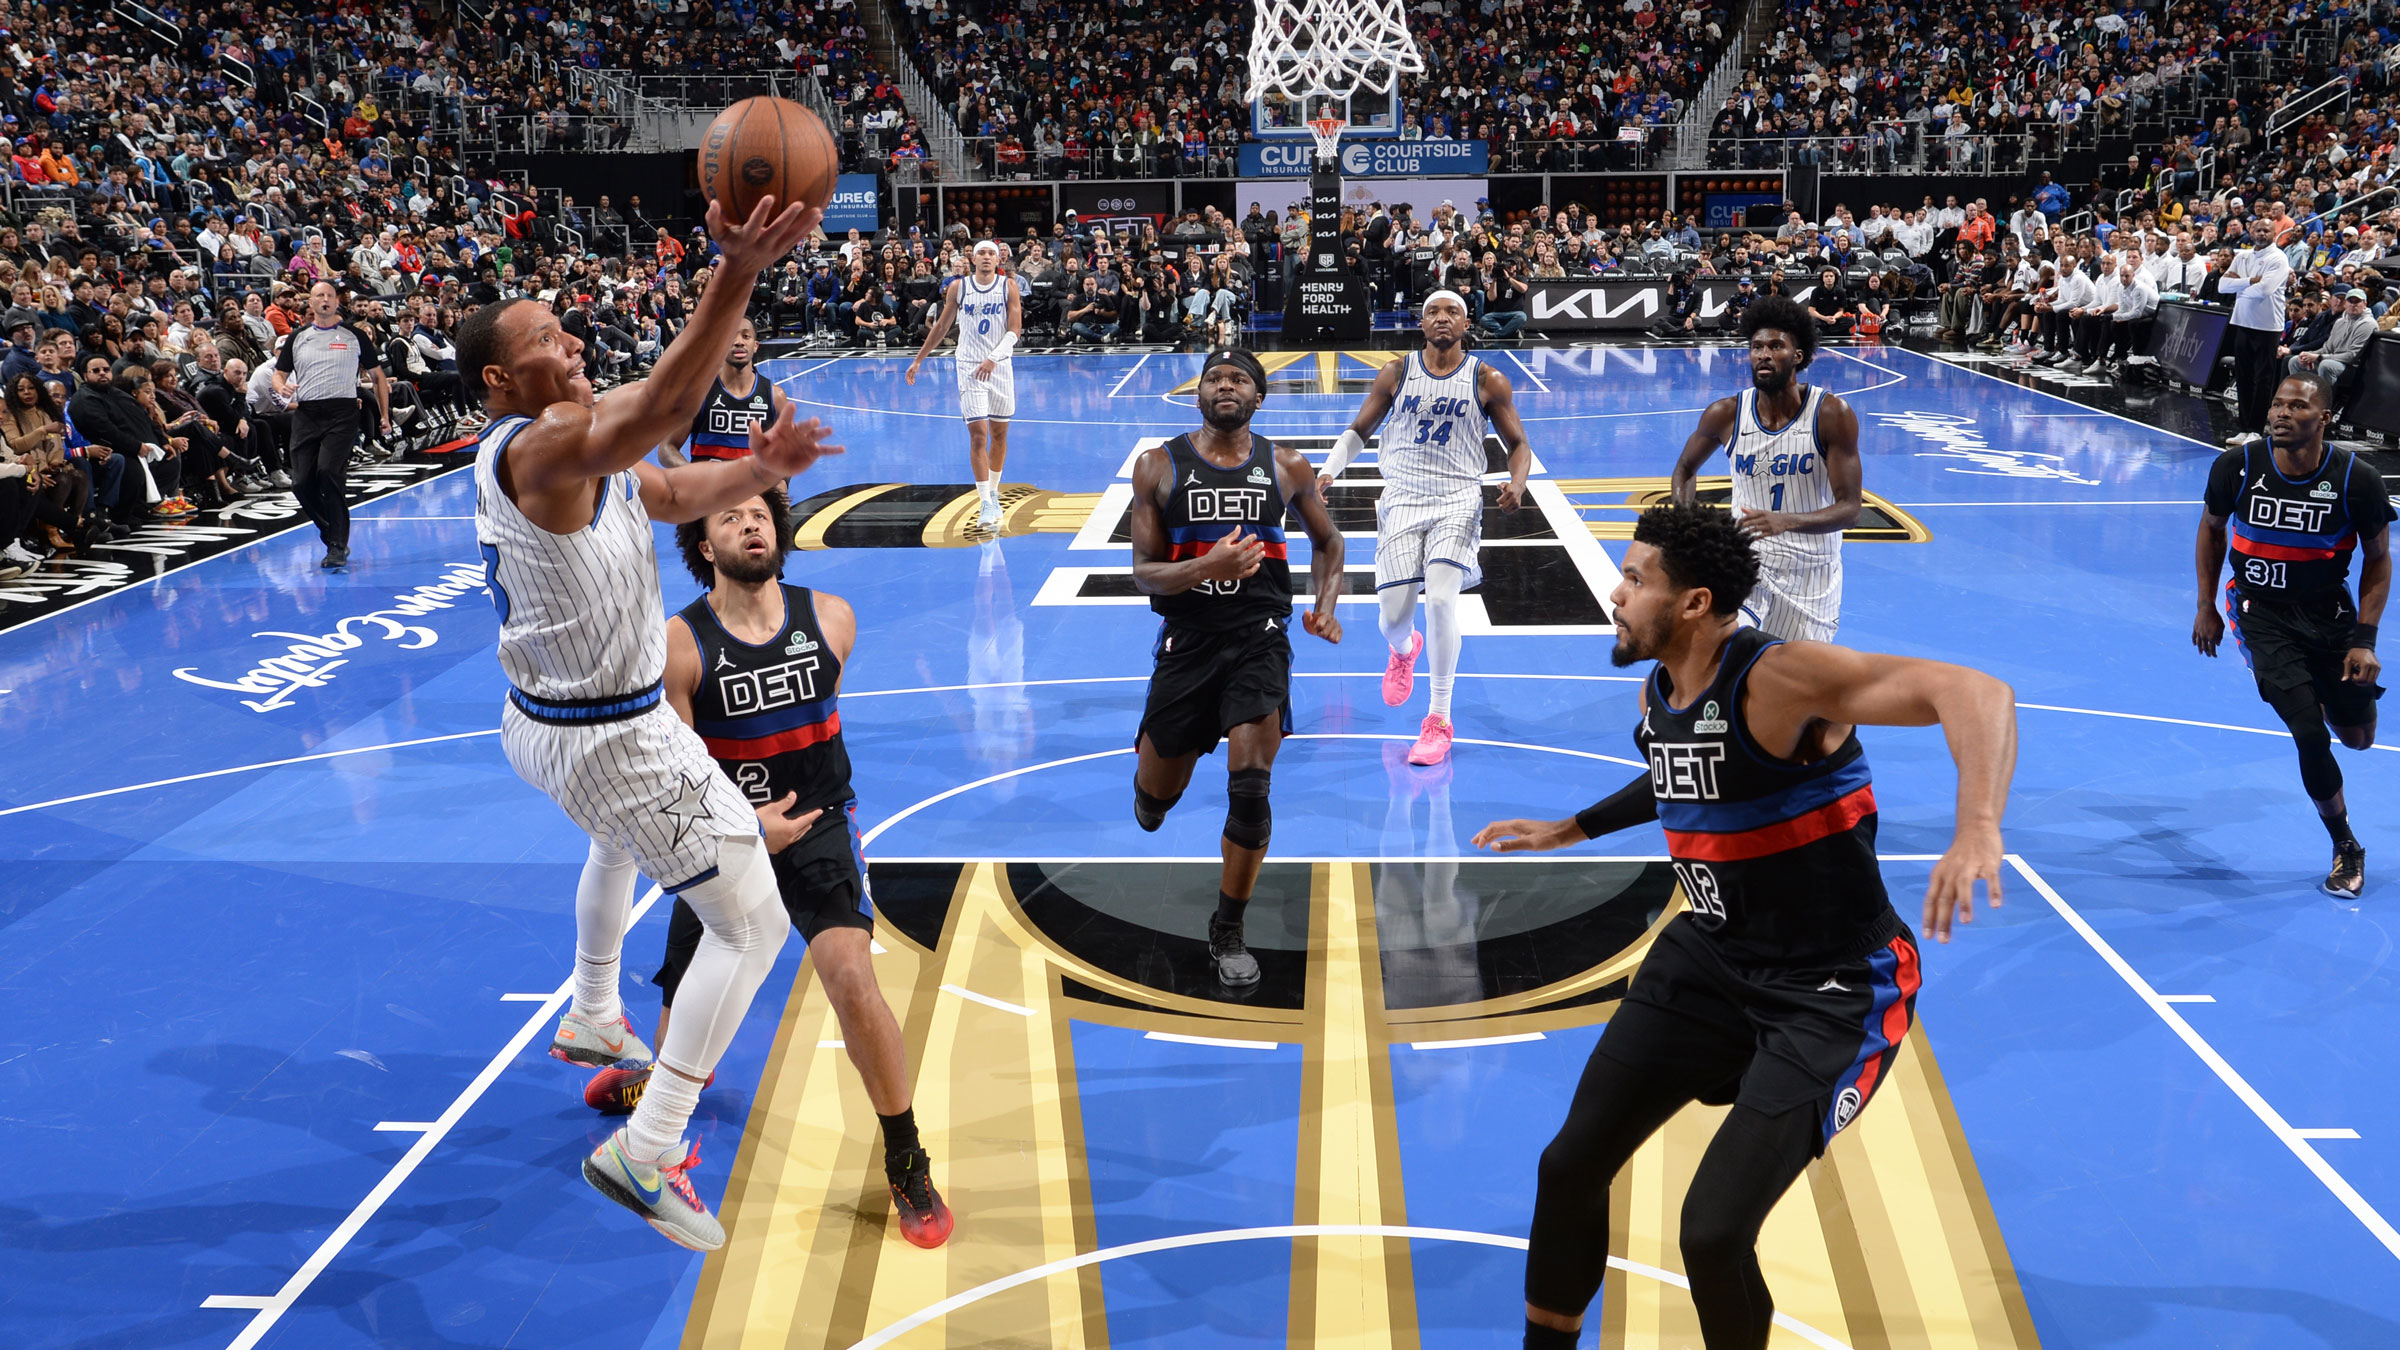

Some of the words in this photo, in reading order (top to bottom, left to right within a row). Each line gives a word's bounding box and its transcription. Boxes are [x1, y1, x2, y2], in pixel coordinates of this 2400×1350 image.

[702, 123, 731, 200] Wilso
[1374, 145, 1471, 158] COURTSIDE
[1374, 159, 1420, 172] CLUB
[830, 192, 863, 204] URE
[1300, 282, 1344, 292] HENRY
[1302, 294, 1335, 303] FORD
[1302, 304, 1352, 314] HEALTH
[1532, 288, 1659, 319] KIA
[978, 319, 990, 335] 0
[709, 409, 767, 434] DET
[1414, 420, 1453, 446] 34
[1188, 488, 1267, 521] DET
[1770, 483, 1785, 511] 1
[2249, 495, 2332, 533] DET
[2245, 559, 2287, 588] 31
[785, 640, 818, 654] StockX
[719, 656, 820, 717] DET
[1694, 721, 1727, 732] StockX
[737, 763, 771, 802] 2
[1649, 741, 1725, 800] DET
[1673, 863, 1727, 920] 12
